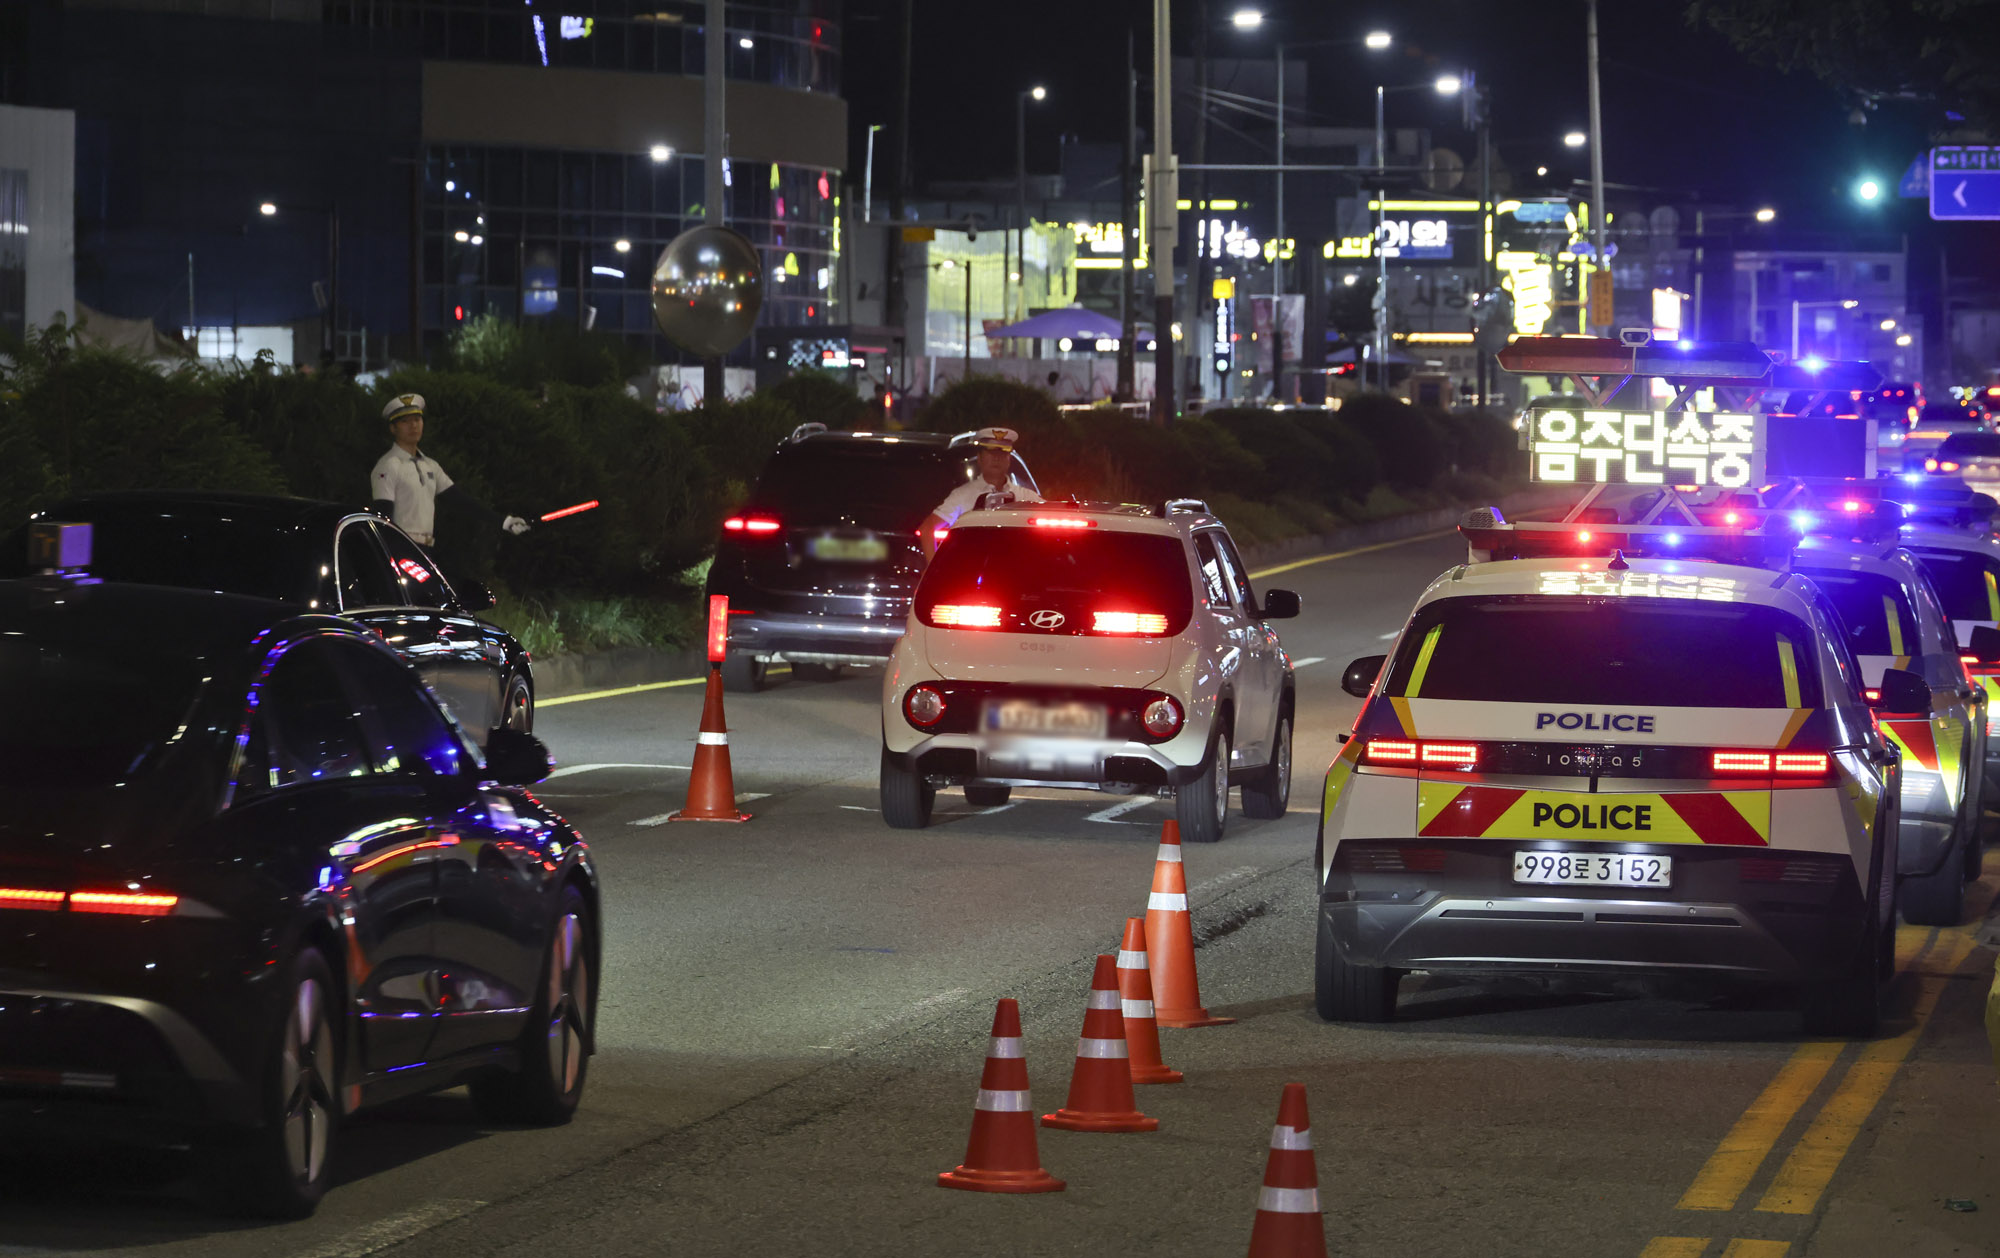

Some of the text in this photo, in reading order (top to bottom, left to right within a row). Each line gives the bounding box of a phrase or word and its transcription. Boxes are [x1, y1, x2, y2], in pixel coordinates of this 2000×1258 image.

[1535, 410, 1754, 488] 음주단속중
[1535, 711, 1655, 731] POLICE
[1632, 757, 1642, 768] 5
[1533, 803, 1651, 830] POLICE
[1525, 855, 1661, 884] 998로 3152
